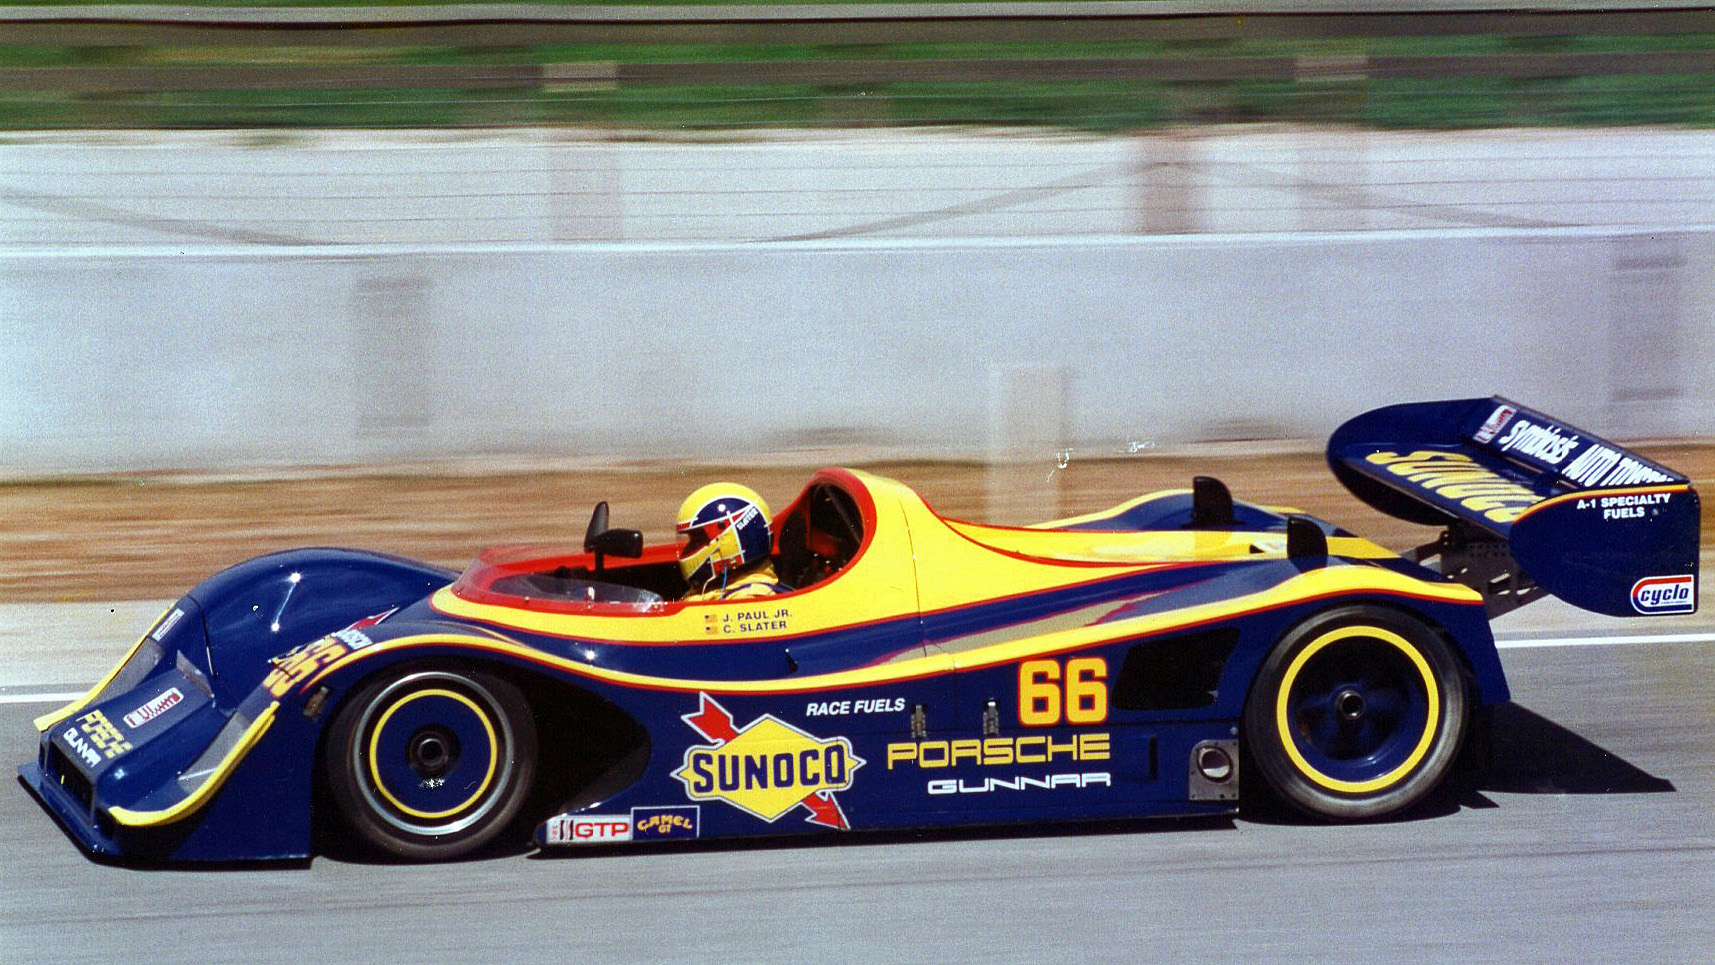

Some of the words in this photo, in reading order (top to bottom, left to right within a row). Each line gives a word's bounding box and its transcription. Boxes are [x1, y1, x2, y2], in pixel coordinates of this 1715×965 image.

[1577, 499, 1596, 510] A-1
[1600, 493, 1671, 508] SPECIALTY
[1603, 507, 1645, 519] FUELS
[1640, 584, 1690, 605] cyclo
[723, 613, 733, 622] J.
[737, 611, 769, 621] PAUL
[773, 609, 793, 618] JR.
[723, 624, 735, 633] C.
[740, 620, 787, 632] SLATER
[1018, 657, 1108, 726] 66
[806, 701, 851, 717] RACE
[854, 698, 905, 713] FUELS
[887, 733, 1111, 769] PORSCHE
[692, 744, 847, 794] SUNOCO
[927, 772, 1111, 795] GUNNAR
[575, 822, 629, 838] GTP
[637, 815, 693, 830] CAMEL
[658, 825, 671, 833] GT
